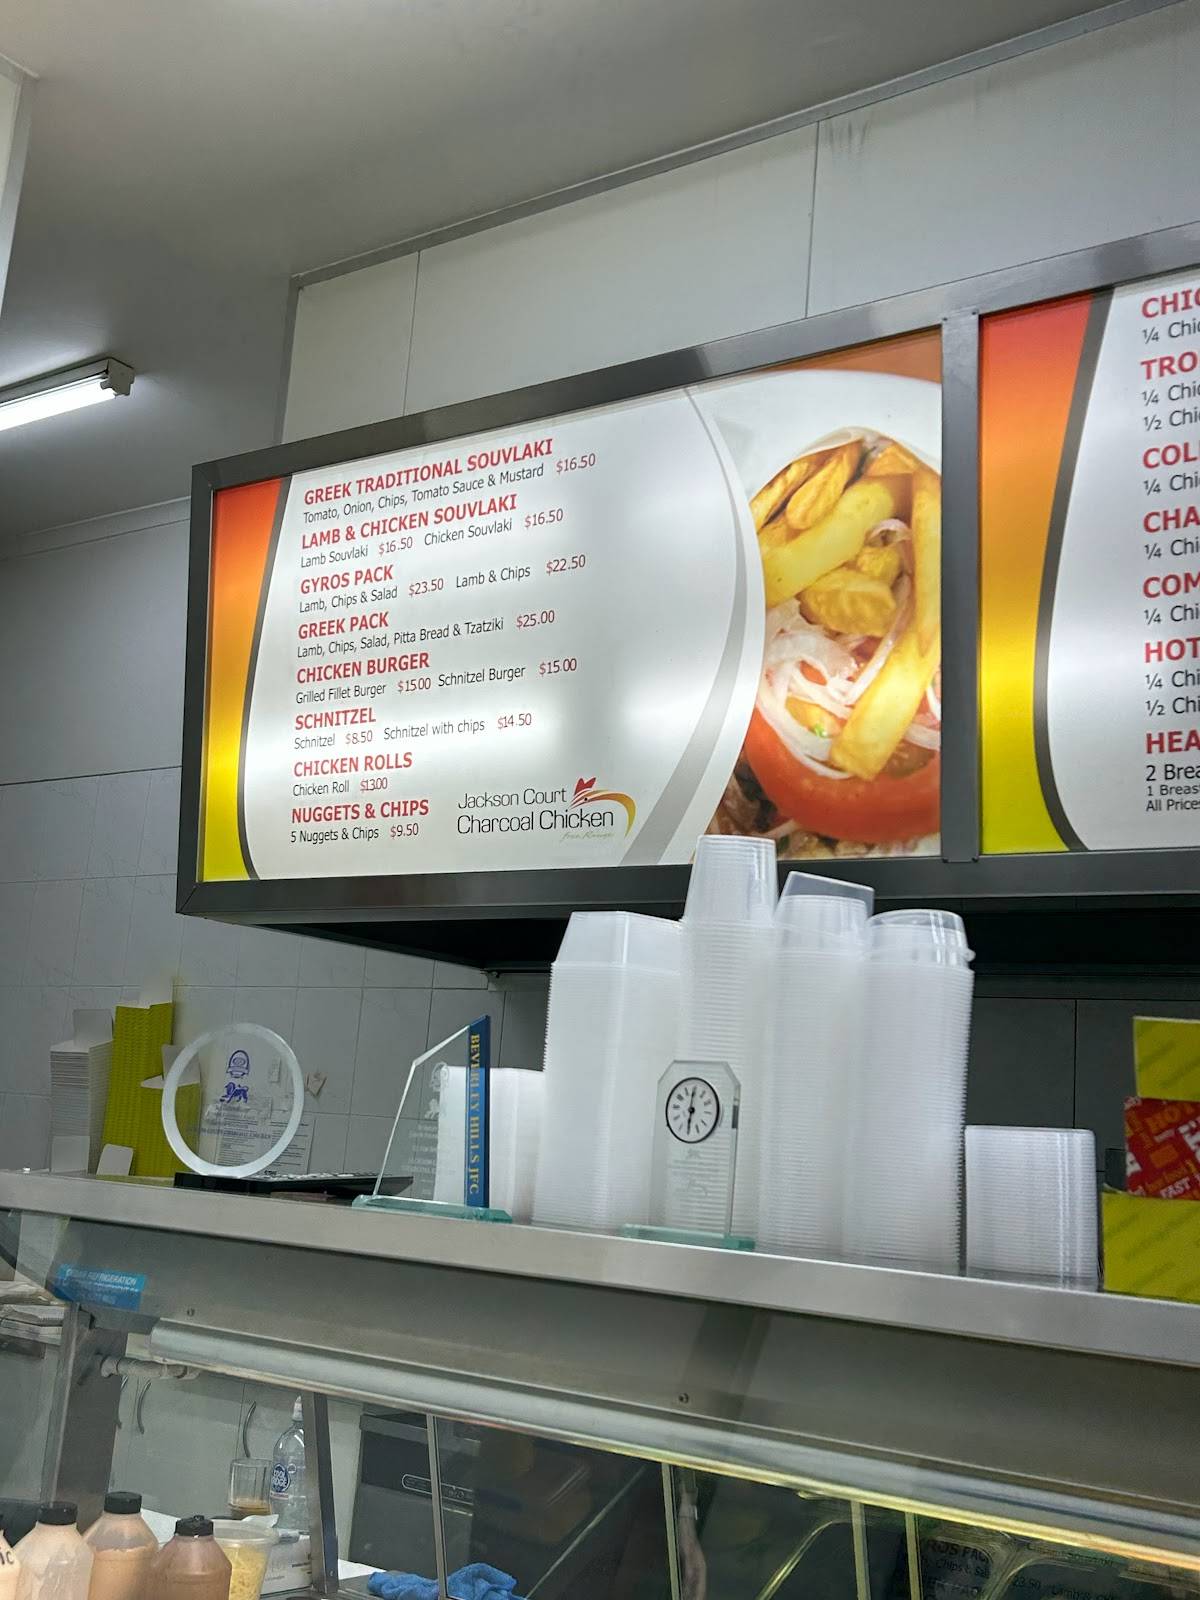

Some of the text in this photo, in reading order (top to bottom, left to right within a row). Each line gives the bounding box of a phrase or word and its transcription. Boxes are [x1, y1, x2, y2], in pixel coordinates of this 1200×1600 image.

[1142, 289, 1200, 319] CHI
[1142, 327, 1160, 344] ¼
[1141, 351, 1200, 380] TRO
[1142, 389, 1160, 406] ¼
[1144, 406, 1200, 432] ½ Chi
[1143, 441, 1200, 469] COL
[304, 438, 552, 505] GREEK TRADITIONAL SOUVLAKI
[1144, 472, 1200, 496] ¼ Chi
[304, 453, 596, 523] Tomato, Onion, Chips, Tomato Sauce & Mustard $16.50
[302, 494, 517, 550] LAMB & CHICKEN SOUVLAKI
[1143, 505, 1200, 533] CHA
[301, 508, 563, 568] Lamb Souvlaki $16.50 Chicken Souvlaki $16.50
[1145, 536, 1200, 560] ¼ Chi
[300, 554, 586, 613] Lamb, Chips & Salad $23.50 Lamb & Chips $22.50
[301, 564, 393, 594] GYROS PACK
[1143, 572, 1200, 598] COM
[298, 611, 389, 639] GREEK PACK
[1144, 603, 1200, 625] ¼ Chi
[298, 610, 555, 658] Lamb, Chips, Salad, Pitta Bread & Tzatziki $25.00
[297, 652, 430, 684] CHICKEN BURGER
[1145, 669, 1200, 690] ¼ Chi
[296, 689, 325, 704] Grilled
[328, 686, 351, 700] Fillet
[354, 684, 387, 698] Burger
[438, 668, 484, 686] Schnitzel
[489, 667, 526, 682] Burger
[295, 707, 376, 730] SCHNITZEL
[1145, 695, 1200, 717] ½ Chi
[294, 734, 335, 749] Schnitzel
[384, 724, 428, 740] Schnitzel
[432, 722, 453, 734] with
[458, 720, 485, 734] chips
[498, 713, 532, 729] $14.50
[1146, 729, 1200, 754] HEA
[294, 752, 412, 777] CHICKEN ROLLS
[1146, 763, 1200, 781] 2 Brea
[293, 783, 328, 796] Chicken
[332, 780, 349, 793] Roll
[458, 788, 567, 812] Jackson Court
[1148, 784, 1200, 796] 1 Breas
[292, 799, 429, 824] NUGGETS & CHIPS
[1146, 799, 1162, 812] All
[290, 822, 419, 844] 5 Nuggets & Chips $9.50
[458, 808, 614, 834] Charcoal Chicken
[470, 1116, 480, 1163] HILLS
[0, 1546, 15, 1565] ic
